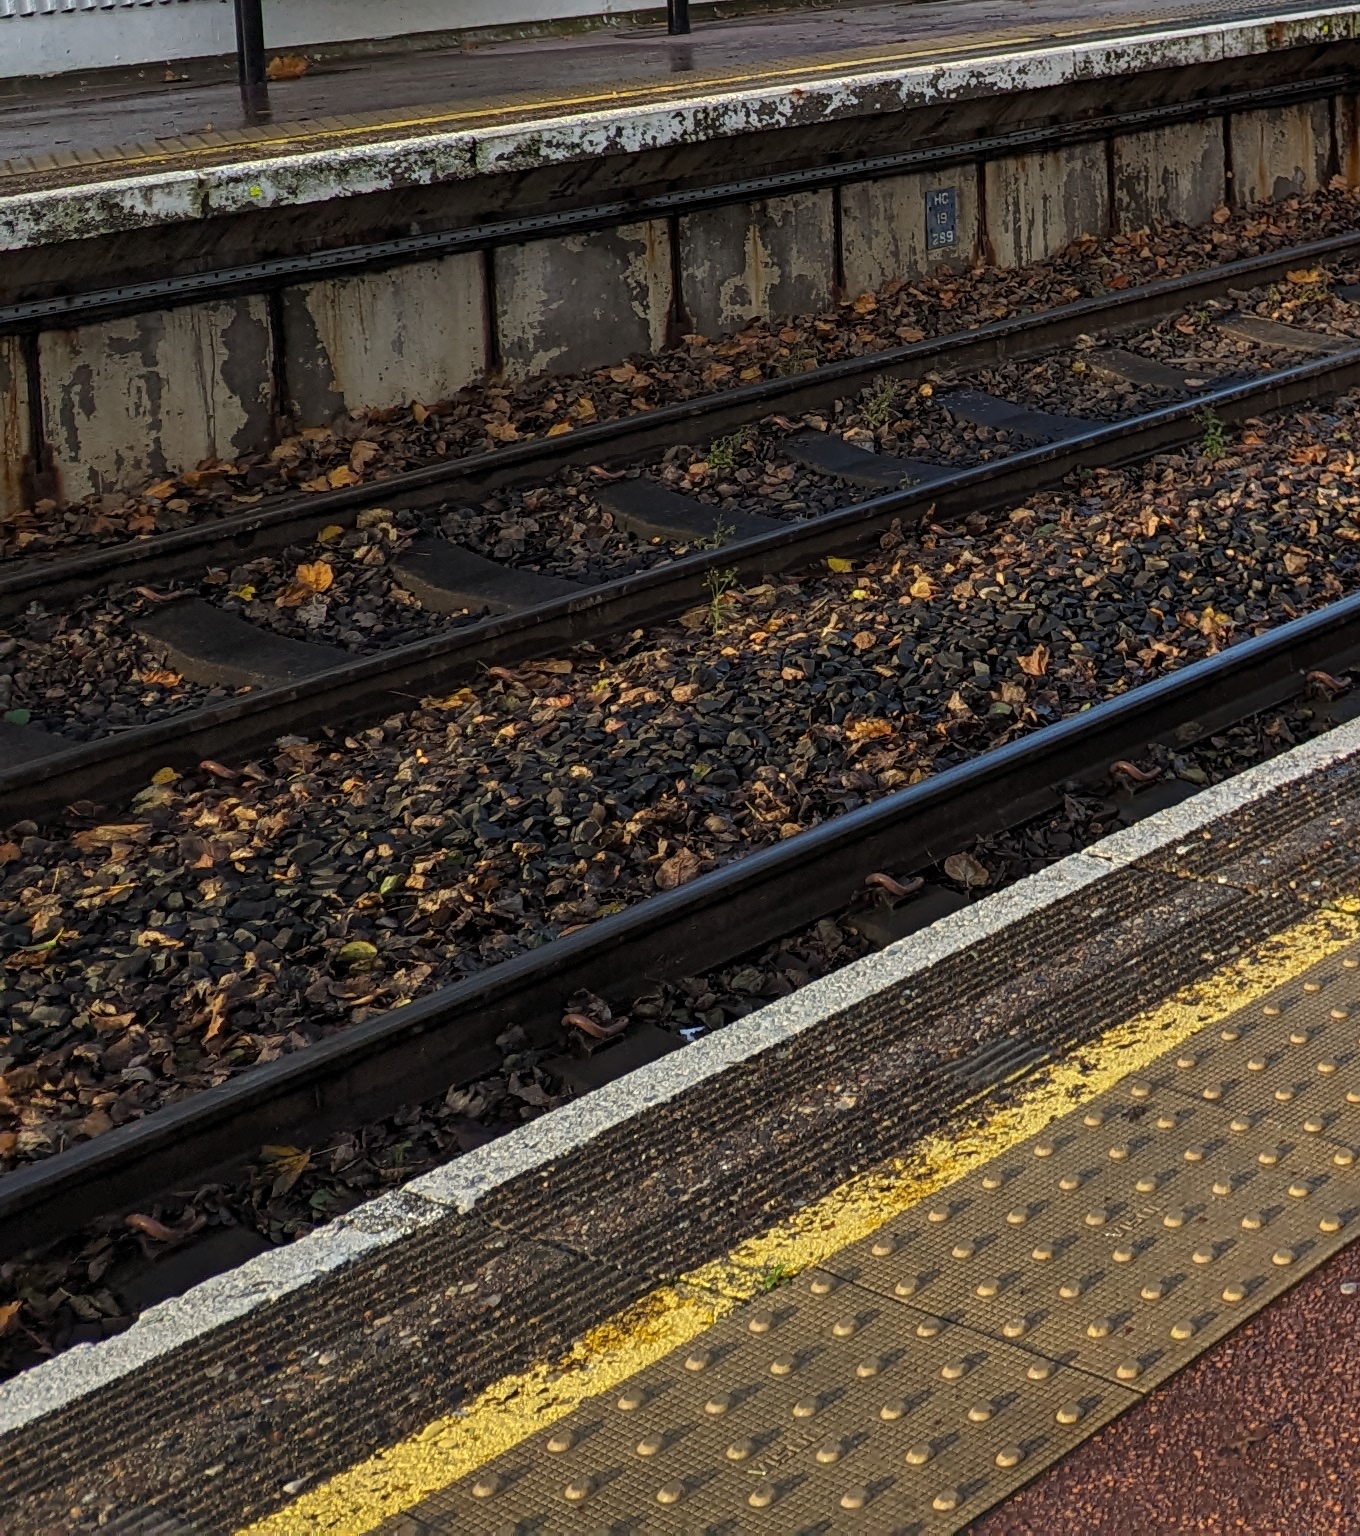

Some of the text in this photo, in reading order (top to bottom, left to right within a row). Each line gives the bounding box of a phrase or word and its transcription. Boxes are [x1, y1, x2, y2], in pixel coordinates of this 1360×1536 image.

[934, 192, 949, 206] HC
[937, 212, 948, 224] 19
[932, 230, 954, 245] 289
